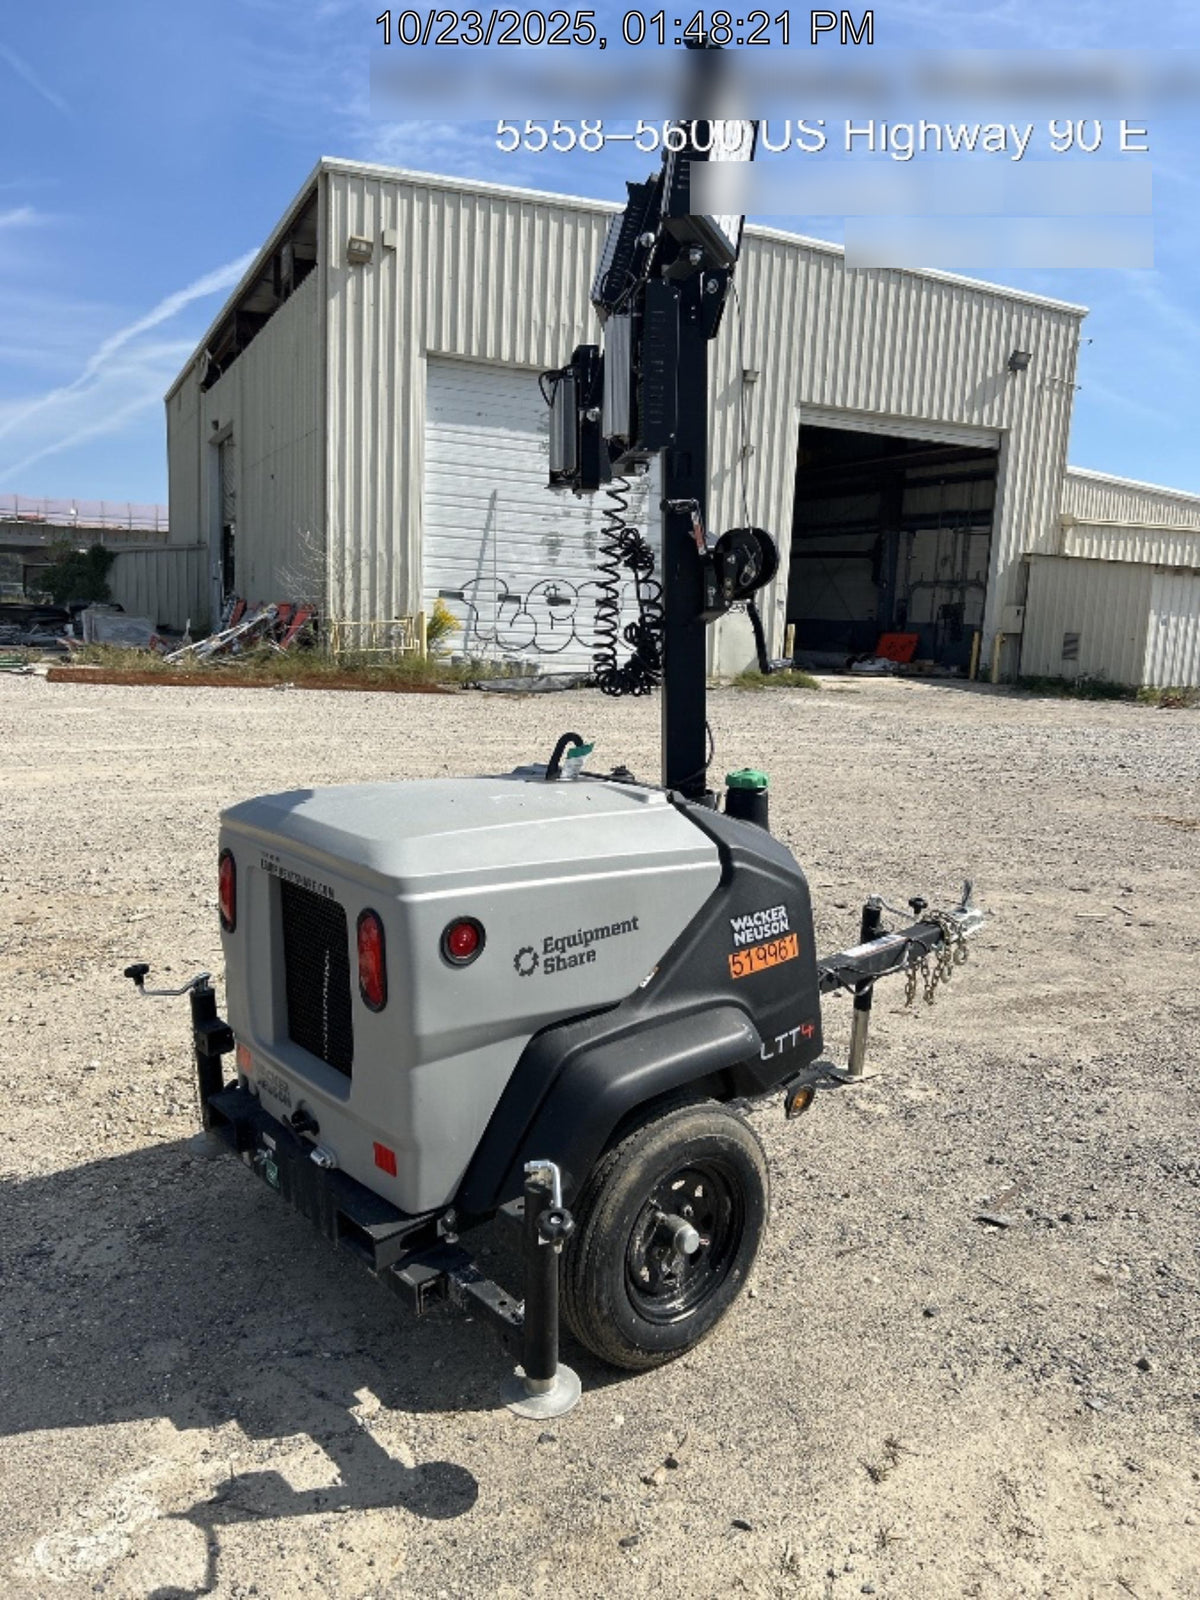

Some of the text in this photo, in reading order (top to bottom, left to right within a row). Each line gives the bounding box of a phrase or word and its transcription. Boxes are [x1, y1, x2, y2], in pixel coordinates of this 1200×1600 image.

[729, 904, 788, 933] WACKER
[733, 918, 790, 947] NEUSON
[542, 915, 640, 955] Equipment
[543, 949, 597, 975] Share
[731, 935, 796, 976] 519961
